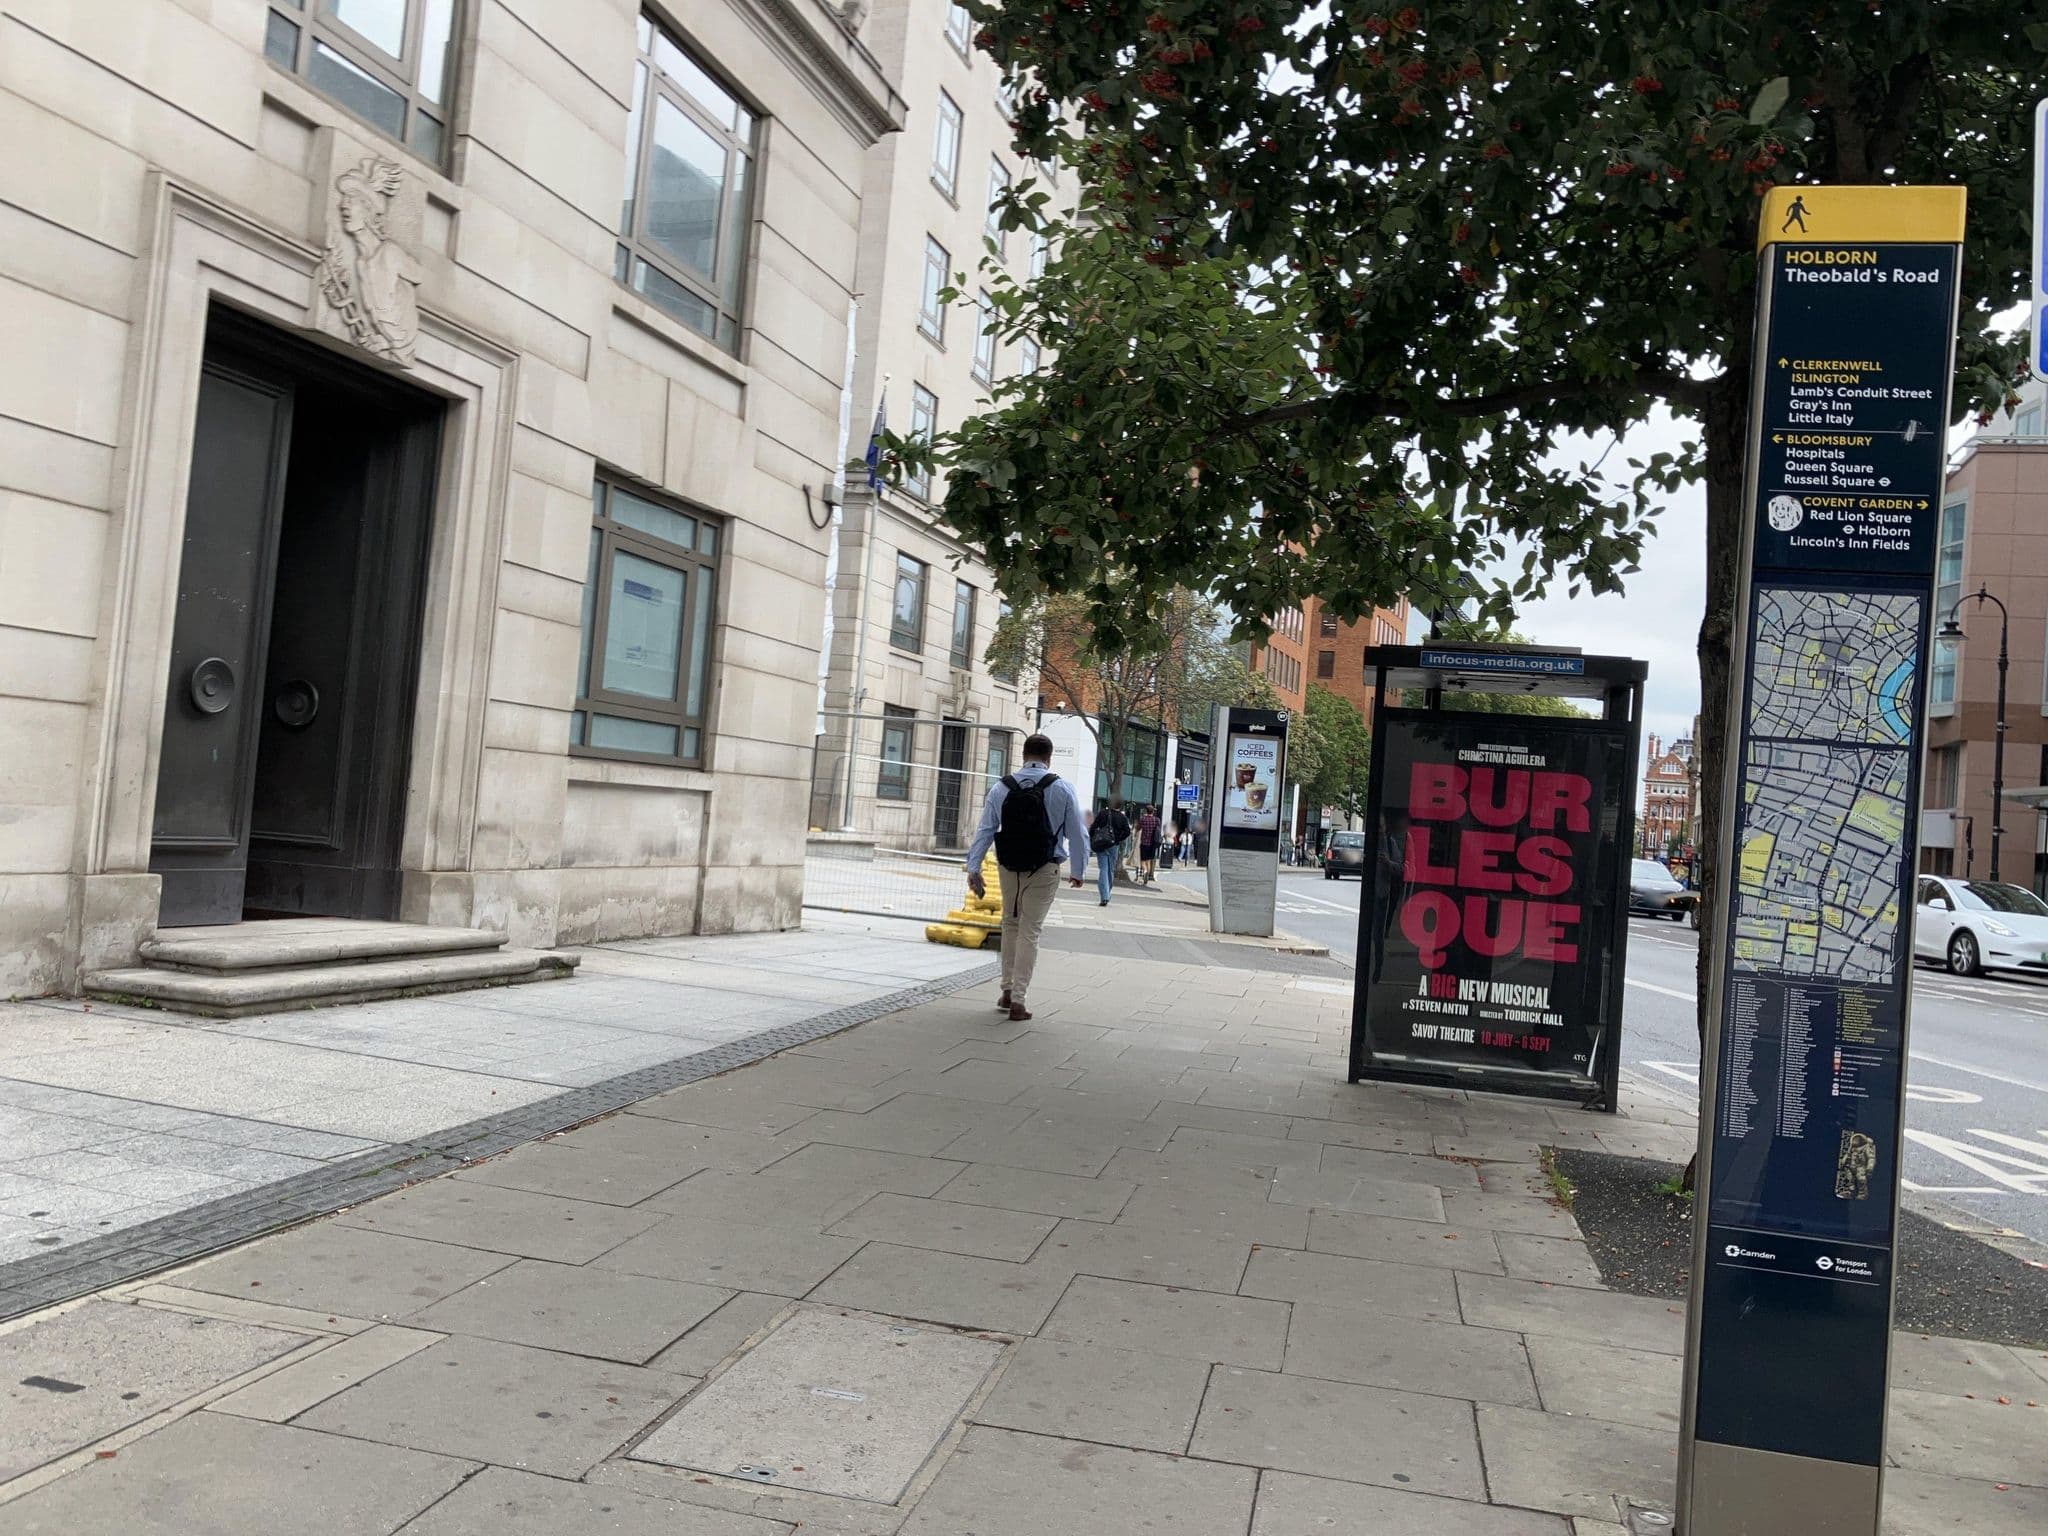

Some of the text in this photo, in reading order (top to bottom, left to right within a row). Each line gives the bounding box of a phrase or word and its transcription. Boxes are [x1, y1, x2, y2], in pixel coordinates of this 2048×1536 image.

[1786, 251, 1877, 264] HOLBORN
[1786, 269, 1939, 283] Theobald's Road
[1793, 360, 1883, 371] CLERKENWELL
[1792, 374, 1859, 384] ISLINGTON
[1790, 387, 1932, 399] Lamb's Conduit Street
[1790, 400, 1852, 412] Gray's Inn
[1789, 413, 1854, 426] Little Italy
[1787, 435, 1872, 446] BLOOMSBURY
[1786, 448, 1845, 459] Hospitals
[1785, 461, 1874, 474] Queen Square
[1784, 474, 1875, 488] Russell Square
[1803, 497, 1913, 509] COVENT GARDEN
[1810, 510, 1912, 525] Red Lion Square
[1859, 525, 1911, 536] Holborn
[1790, 536, 1910, 551] Lincoln's Inn Fields
[1428, 654, 1575, 671] infocus-media.org.uk
[1238, 749, 1273, 757] COFFEES
[1458, 750, 1545, 766] CHRISTINA AGUILERA
[1409, 762, 1592, 832] BUR
[1404, 826, 1573, 896] LES
[1400, 890, 1581, 969] QUE
[1418, 974, 1550, 1009] A BIG NEW MUSICAL
[1409, 999, 1441, 1013] STEVEN
[1442, 1002, 1469, 1016] ANTIN
[1504, 1009, 1541, 1024] TODRICK
[1543, 1013, 1563, 1026] HALL
[1412, 1024, 1475, 1044] SAVOY THEATRE
[1481, 1031, 1491, 1045] 10
[1493, 1033, 1514, 1048] JULY
[1522, 1036, 1528, 1049] 6
[1529, 1036, 1551, 1052] SEPT
[1740, 1249, 1776, 1260] Camden
[1835, 1258, 1867, 1268] Transport
[1835, 1265, 1872, 1276] for London
